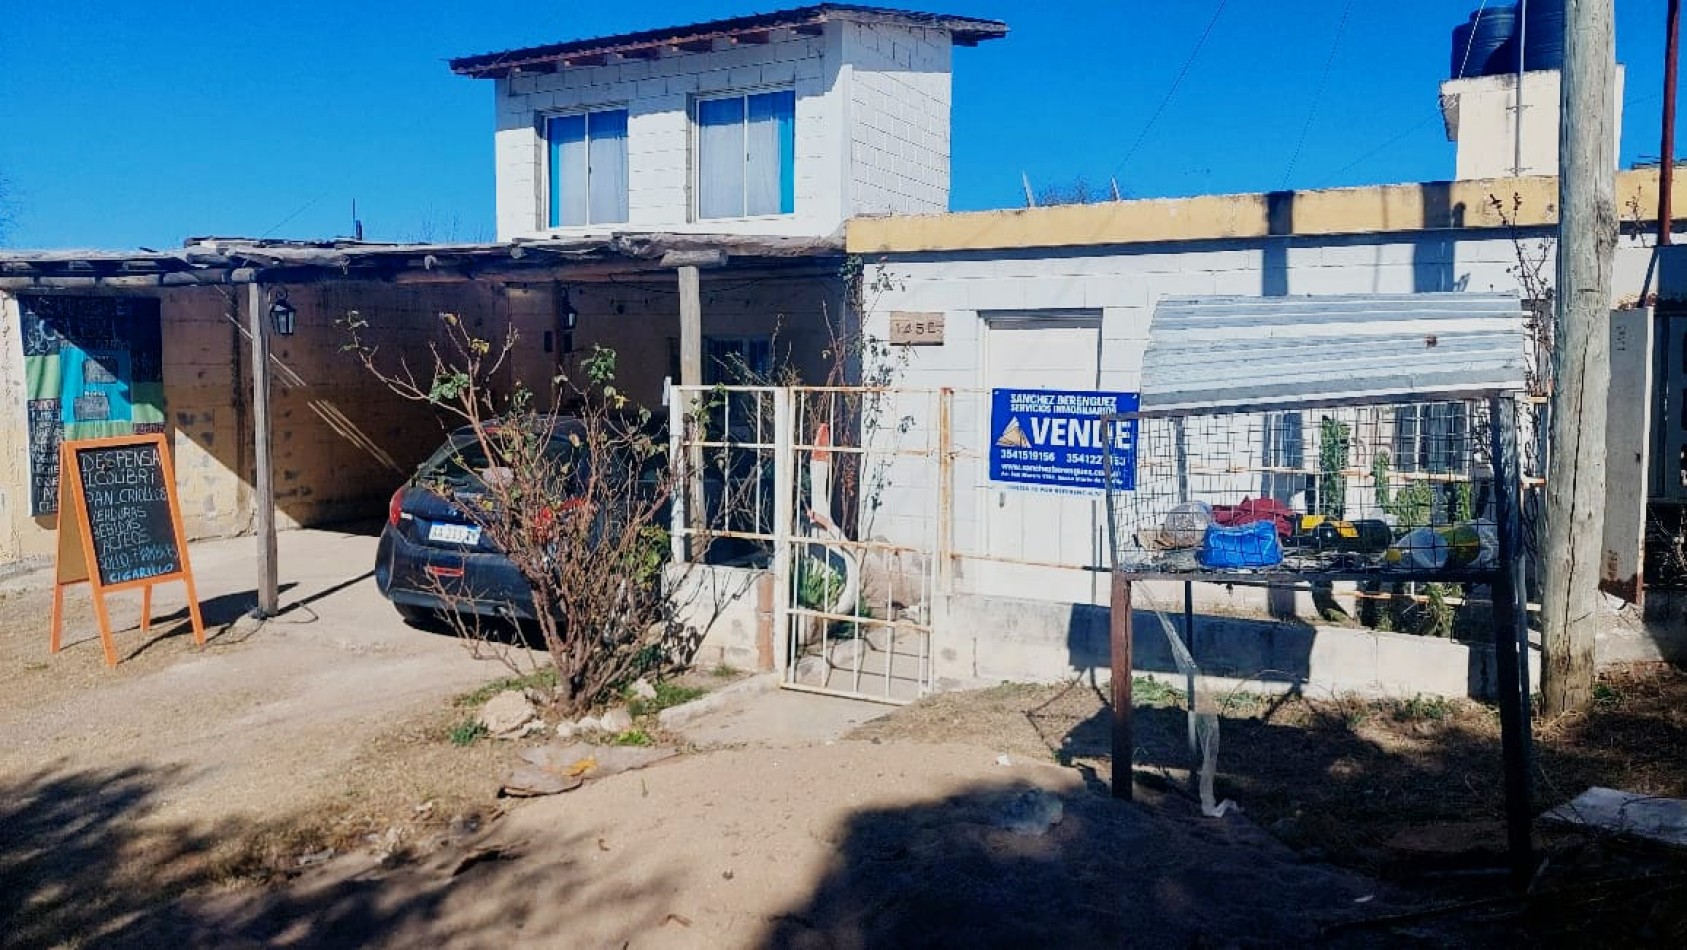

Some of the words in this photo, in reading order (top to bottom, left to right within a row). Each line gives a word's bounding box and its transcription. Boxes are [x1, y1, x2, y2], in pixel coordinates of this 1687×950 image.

[1010, 393, 1055, 405] SANCHEZ
[1010, 404, 1051, 413] SERVICIOS
[1030, 417, 1132, 449] VENDE
[80, 448, 161, 472] DESPENSA
